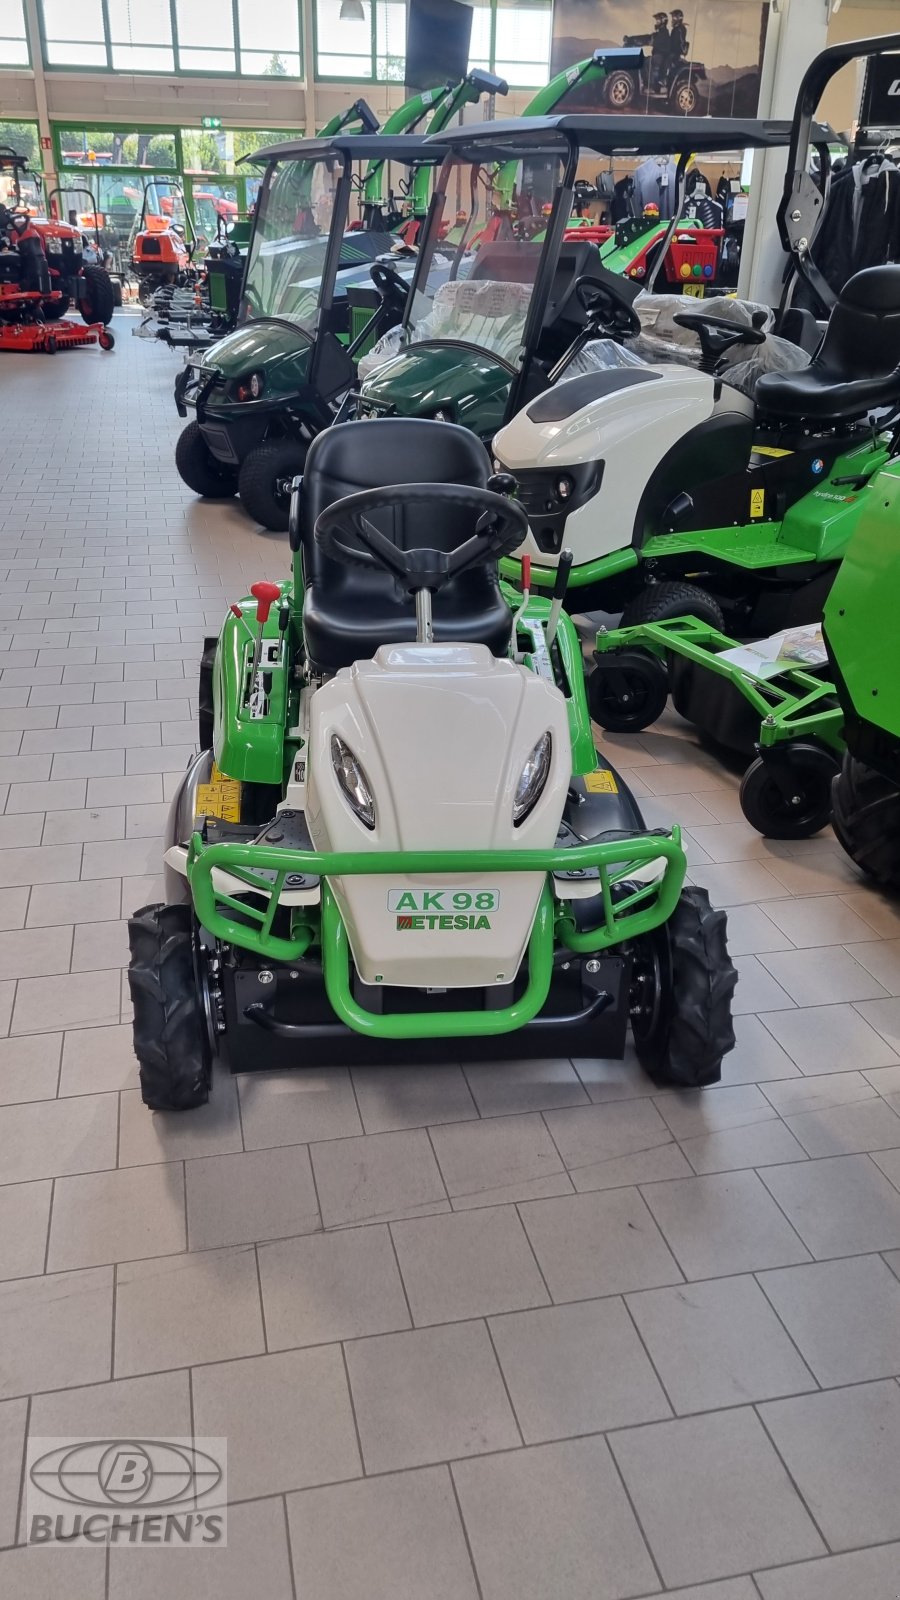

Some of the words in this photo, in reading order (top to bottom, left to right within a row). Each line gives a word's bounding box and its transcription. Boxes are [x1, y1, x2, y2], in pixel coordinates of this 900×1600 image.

[395, 892, 445, 911] AK
[452, 892, 495, 911] 98
[410, 914, 491, 930] ETESIA
